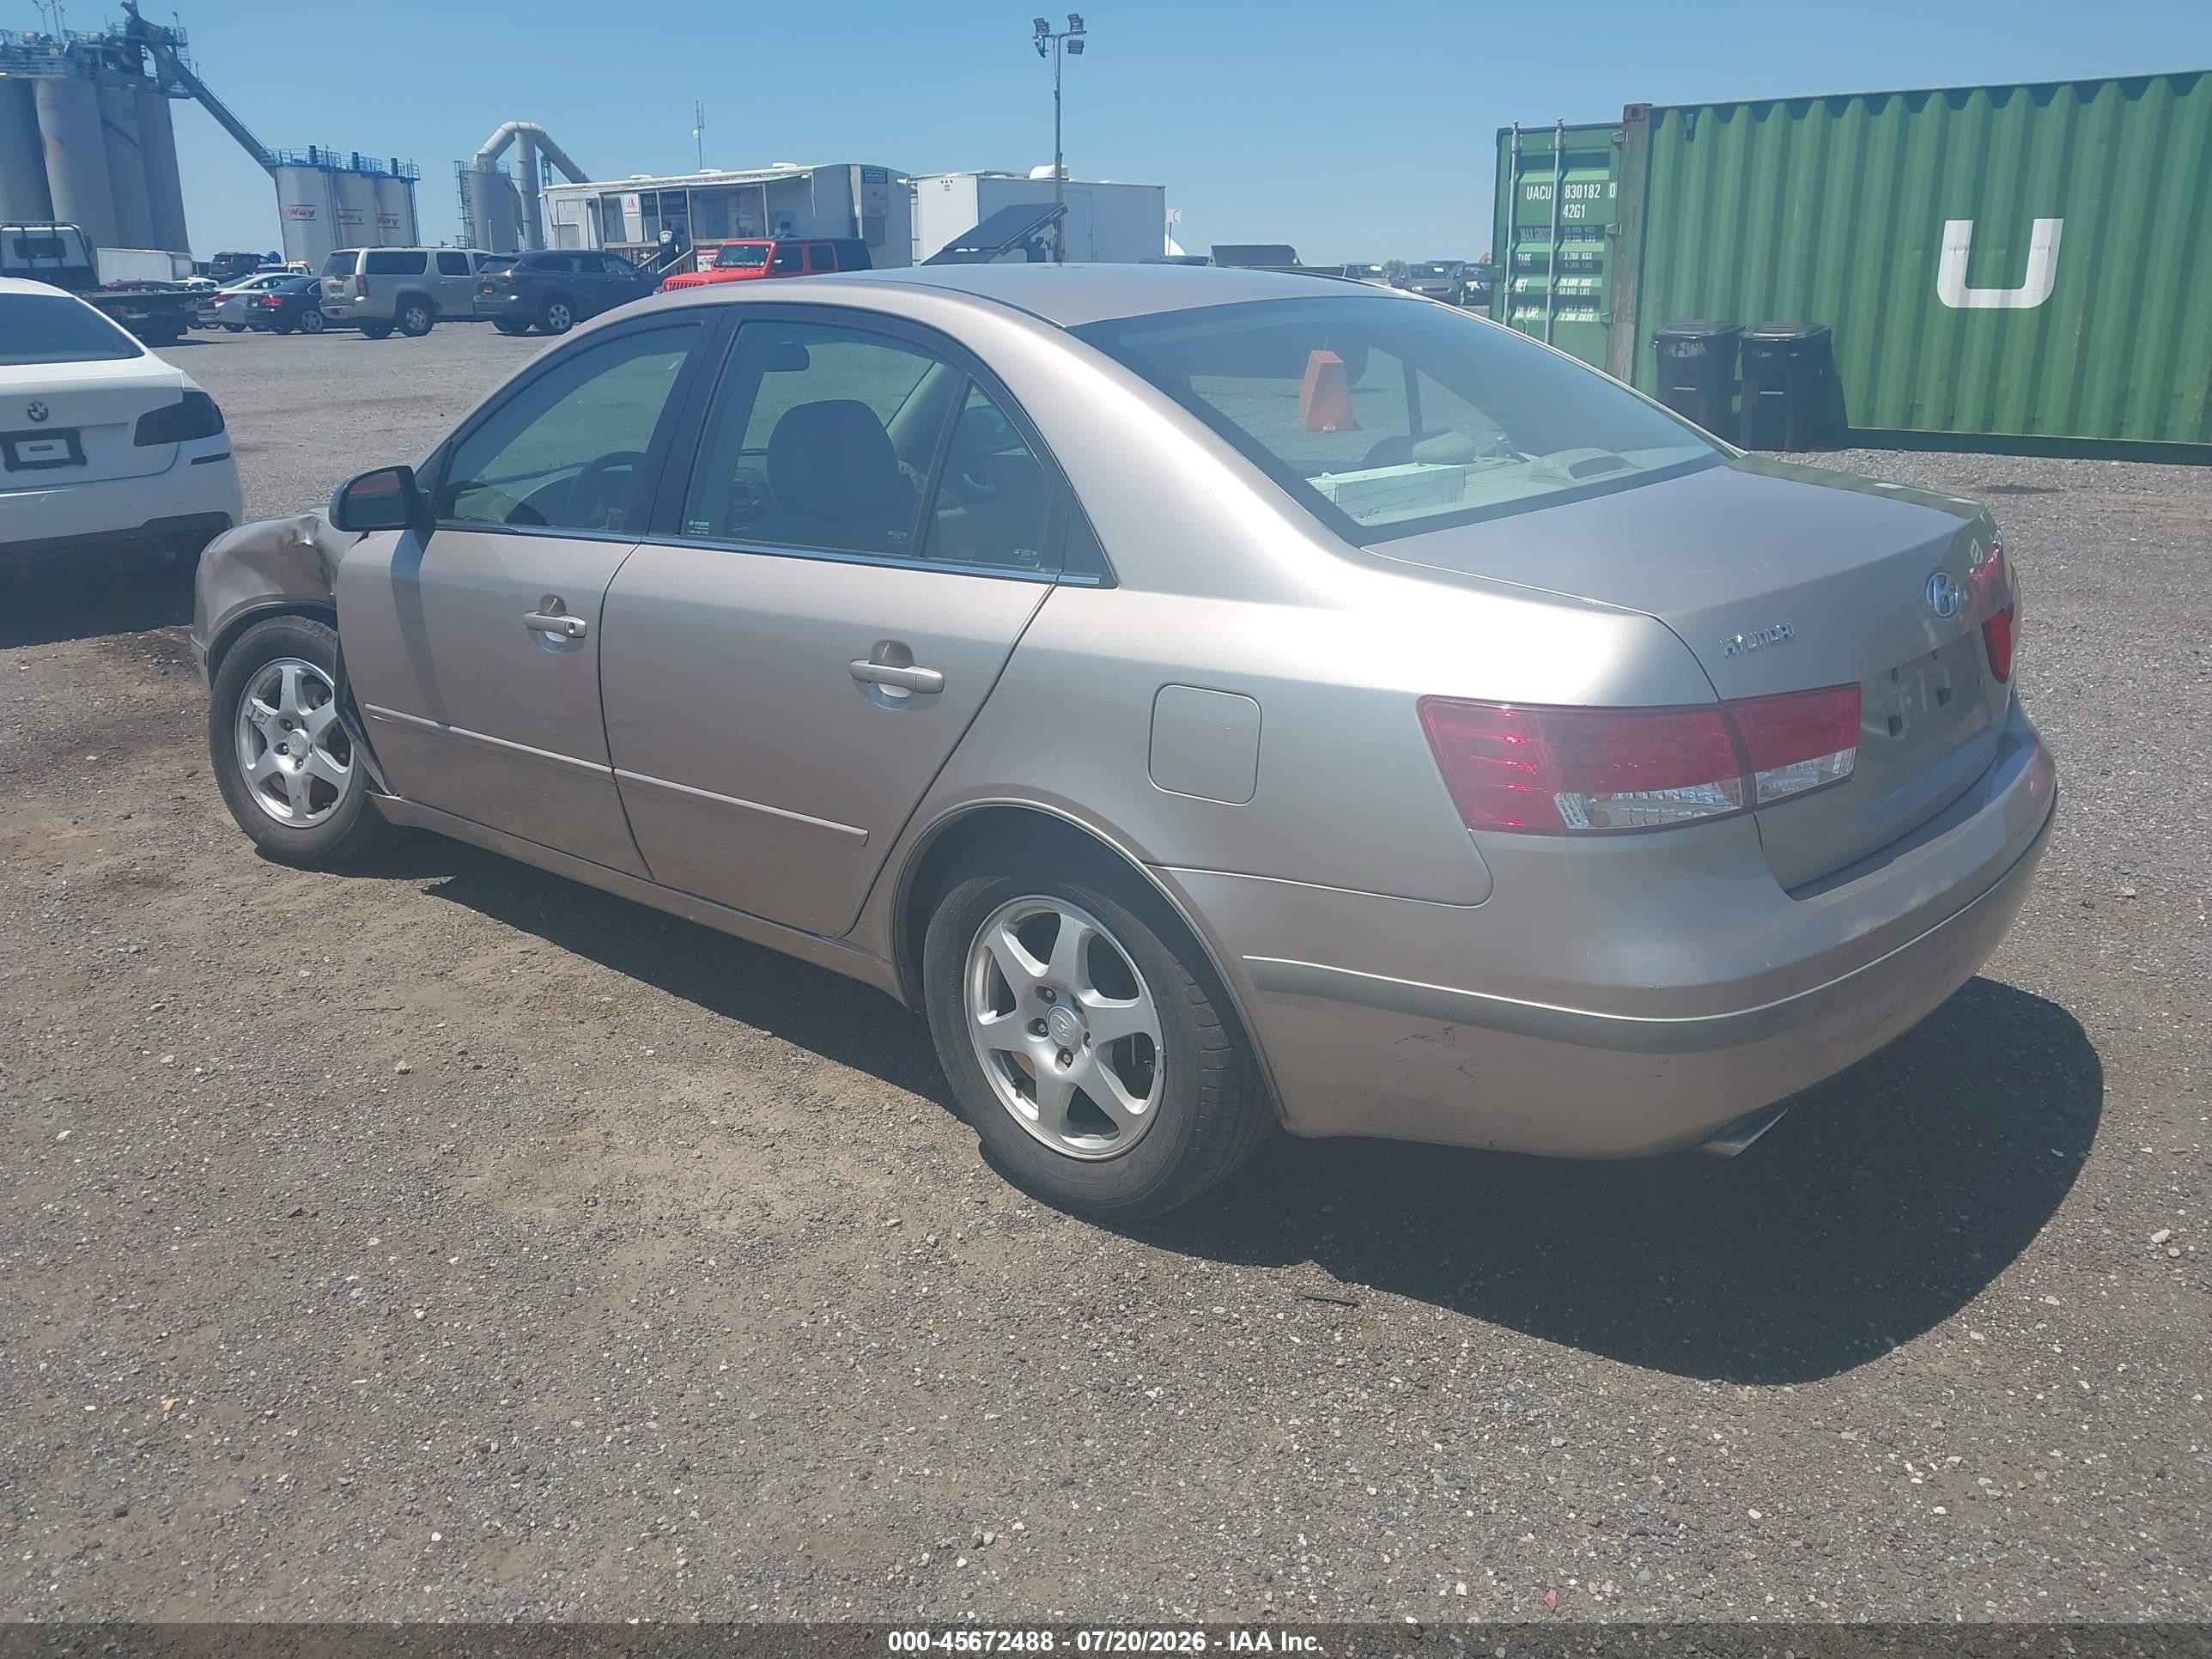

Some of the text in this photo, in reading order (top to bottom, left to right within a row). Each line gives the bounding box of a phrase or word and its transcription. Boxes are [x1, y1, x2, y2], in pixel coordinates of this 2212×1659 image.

[1526, 183, 1617, 200] UACU 830182 0
[1563, 204, 1586, 218] 42G1
[1937, 218, 2064, 308] U
[1719, 621, 1794, 657] HYUNDAI
